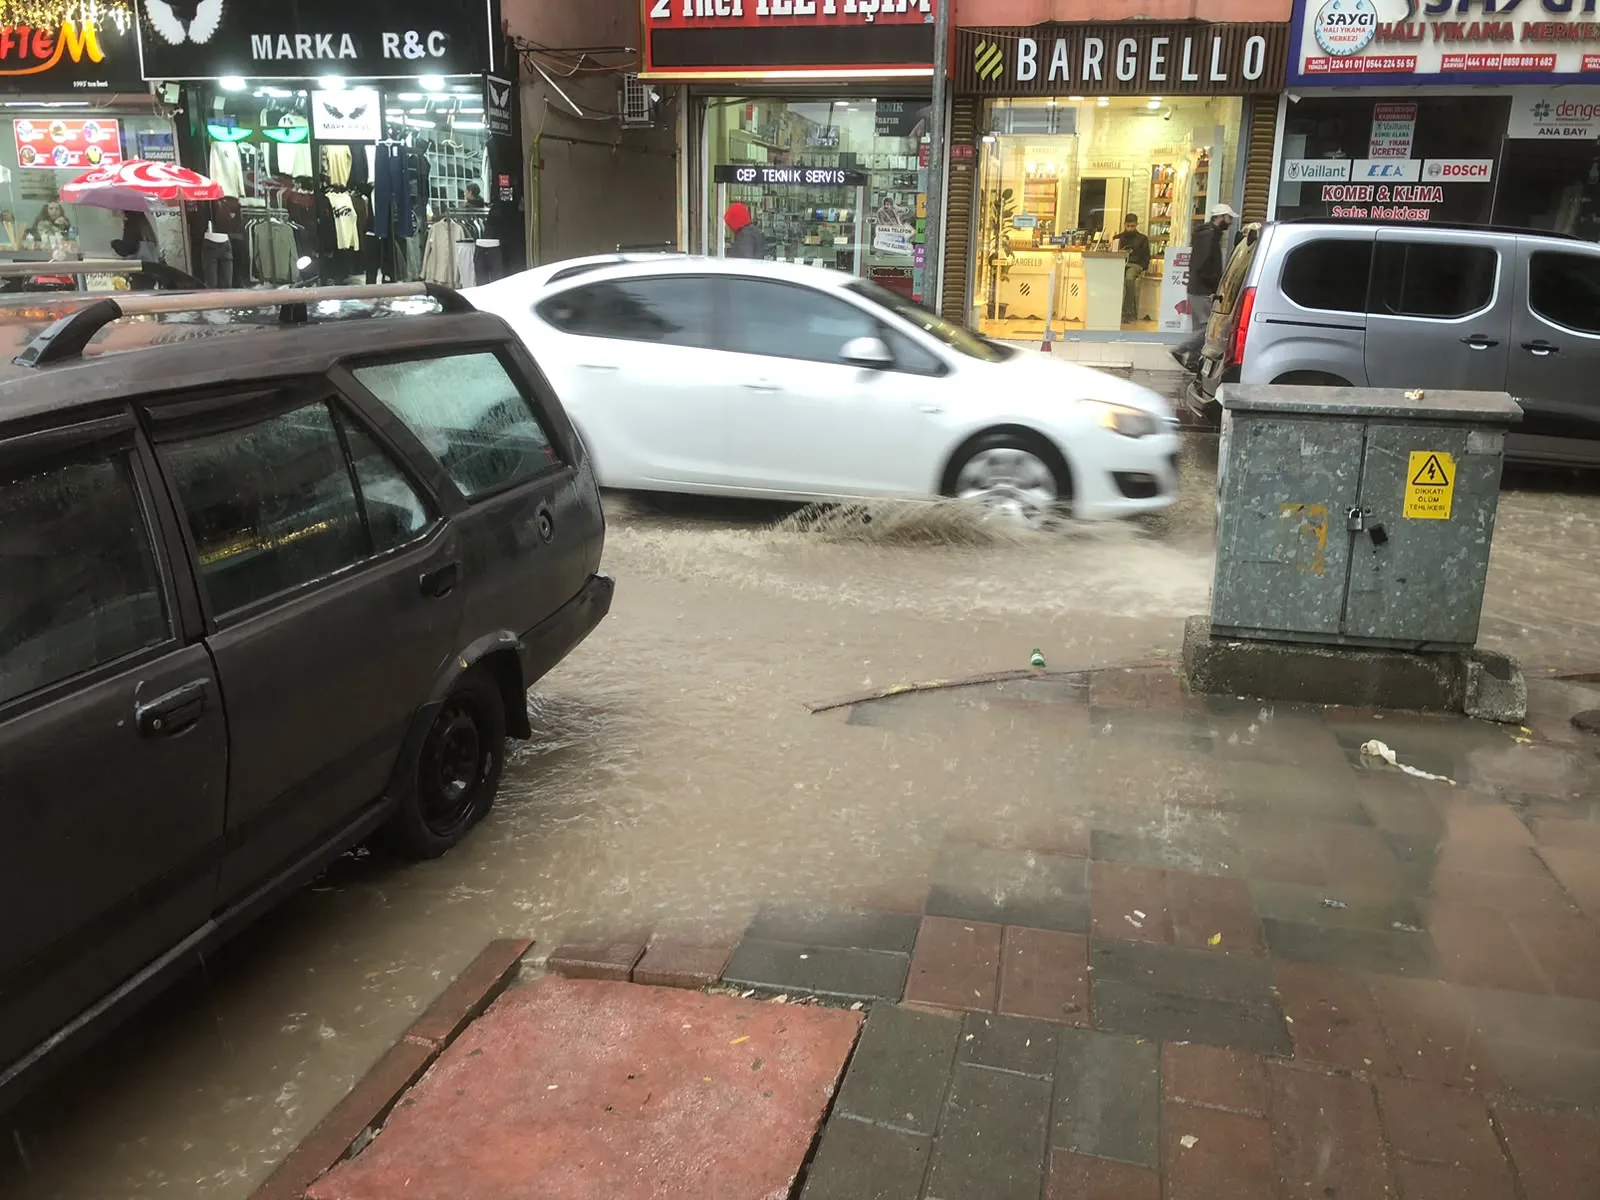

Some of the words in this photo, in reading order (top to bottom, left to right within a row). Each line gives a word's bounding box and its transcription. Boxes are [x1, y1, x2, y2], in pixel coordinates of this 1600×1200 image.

[1326, 14, 1375, 26] SAYGI
[1375, 22, 1427, 41] HALI
[1430, 21, 1514, 41] YIKAMA
[251, 33, 358, 60] MARKA
[382, 30, 446, 60] R&C
[1016, 36, 1266, 82] BARGELLO
[736, 169, 757, 182] CEP
[1301, 165, 1346, 178] Vaillant
[1442, 165, 1488, 176] BOSCH
[1376, 185, 1391, 202] &
[1370, 206, 1430, 221] Noktası
